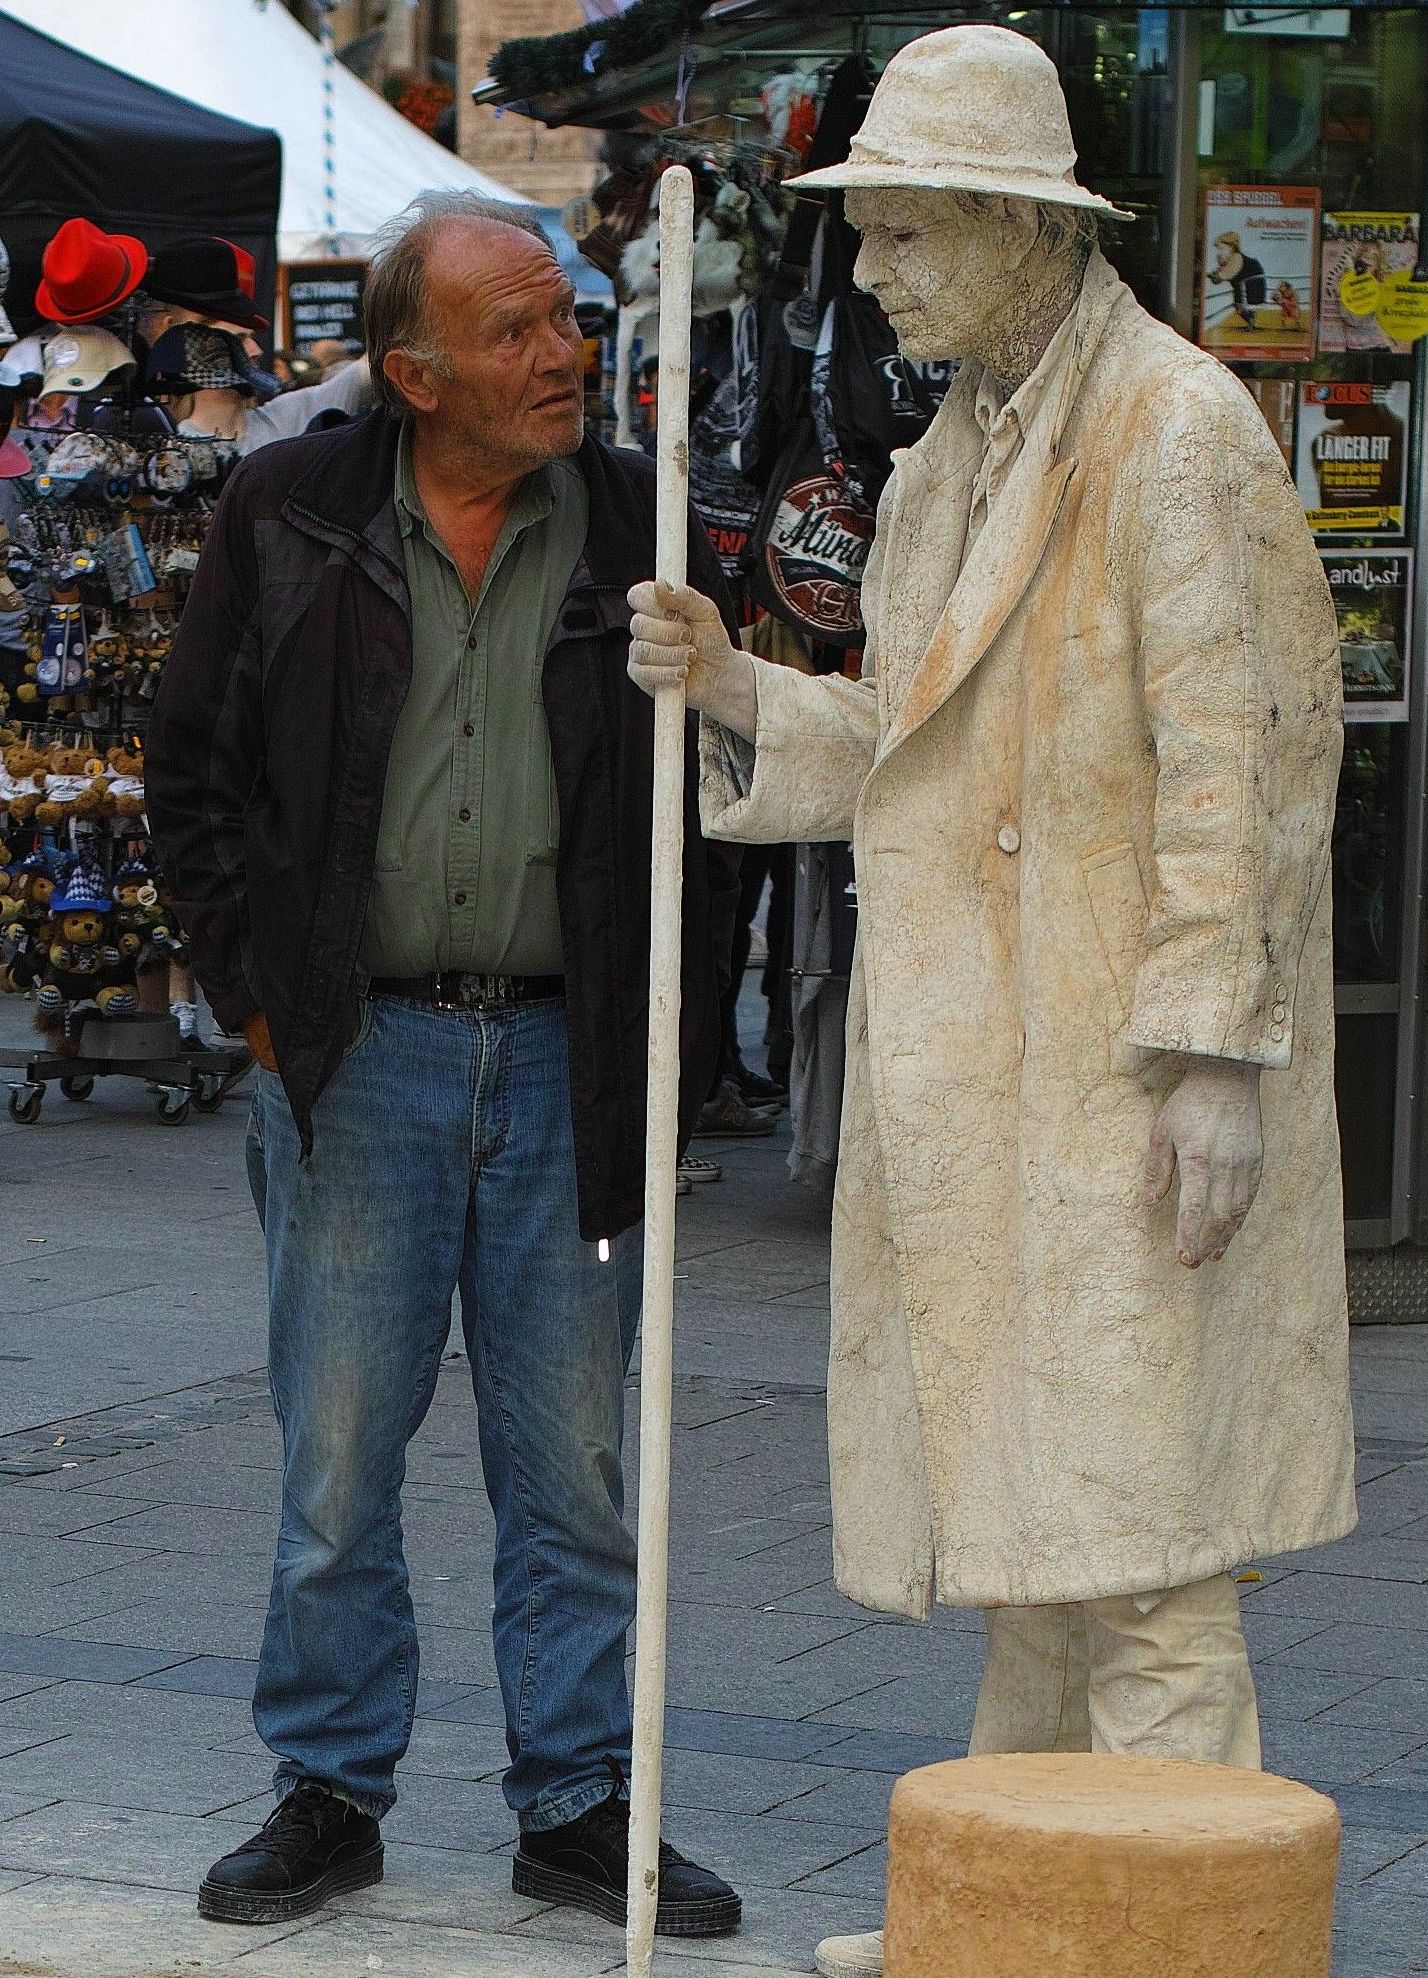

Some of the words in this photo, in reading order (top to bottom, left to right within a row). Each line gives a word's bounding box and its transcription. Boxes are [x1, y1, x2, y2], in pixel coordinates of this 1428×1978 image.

[1304, 383, 1370, 404] FOCUS
[1316, 434, 1369, 460] LANGER
[1370, 436, 1392, 461] FIT
